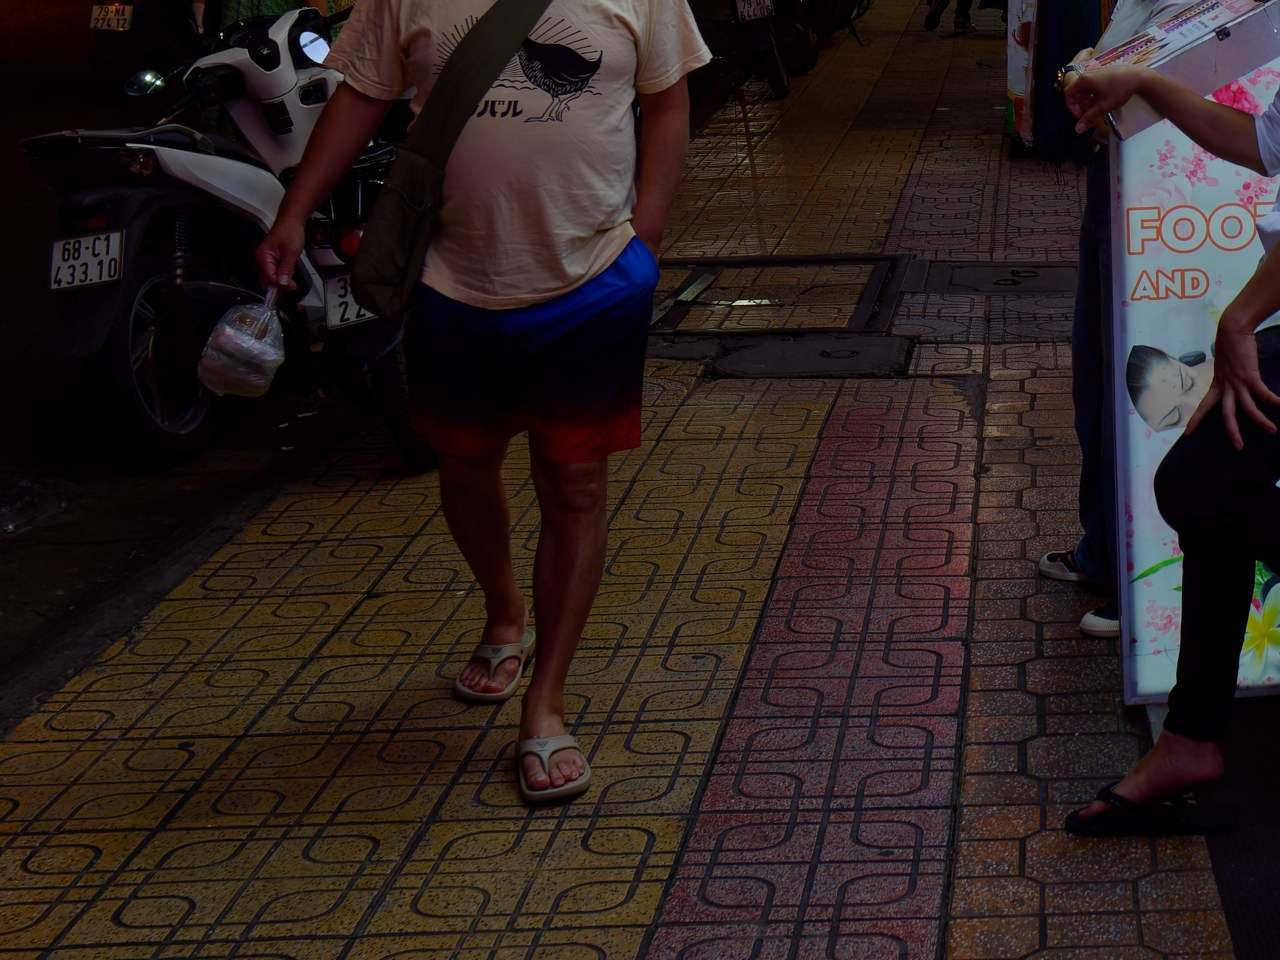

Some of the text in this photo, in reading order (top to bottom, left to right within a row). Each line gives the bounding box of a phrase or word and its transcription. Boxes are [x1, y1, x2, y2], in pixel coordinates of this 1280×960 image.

[62, 234, 111, 262] 68-C1
[54, 257, 118, 287] 433.10
[1130, 268, 1210, 301] AND
